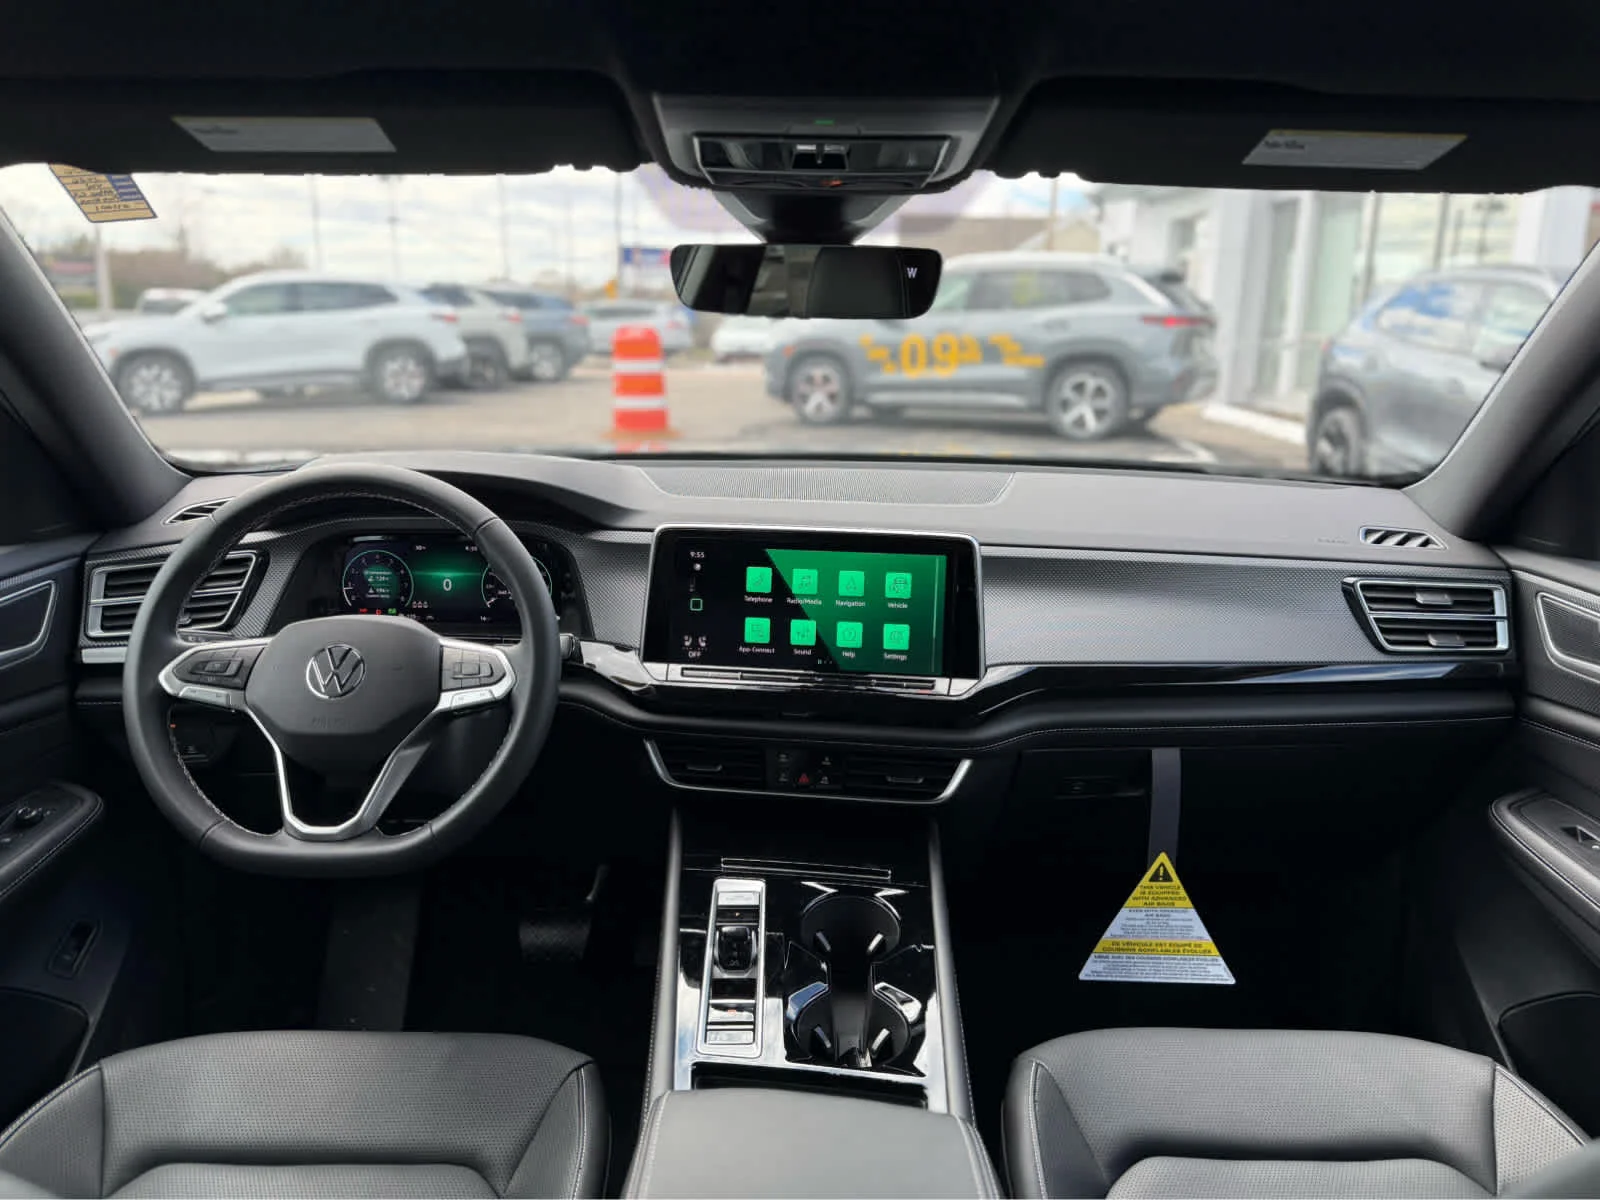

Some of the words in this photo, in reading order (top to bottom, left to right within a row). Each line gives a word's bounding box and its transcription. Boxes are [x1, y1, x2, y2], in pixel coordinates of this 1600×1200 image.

[906, 267, 918, 279] W
[689, 551, 705, 559] 9:55
[442, 578, 453, 592] 0
[743, 595, 773, 604] Telephone
[786, 597, 823, 606] Radio/Media
[835, 599, 866, 608] Navigation
[738, 645, 776, 654] App-Connect
[793, 648, 812, 656] Sound
[842, 650, 856, 659] Help
[883, 652, 908, 661] Settings
